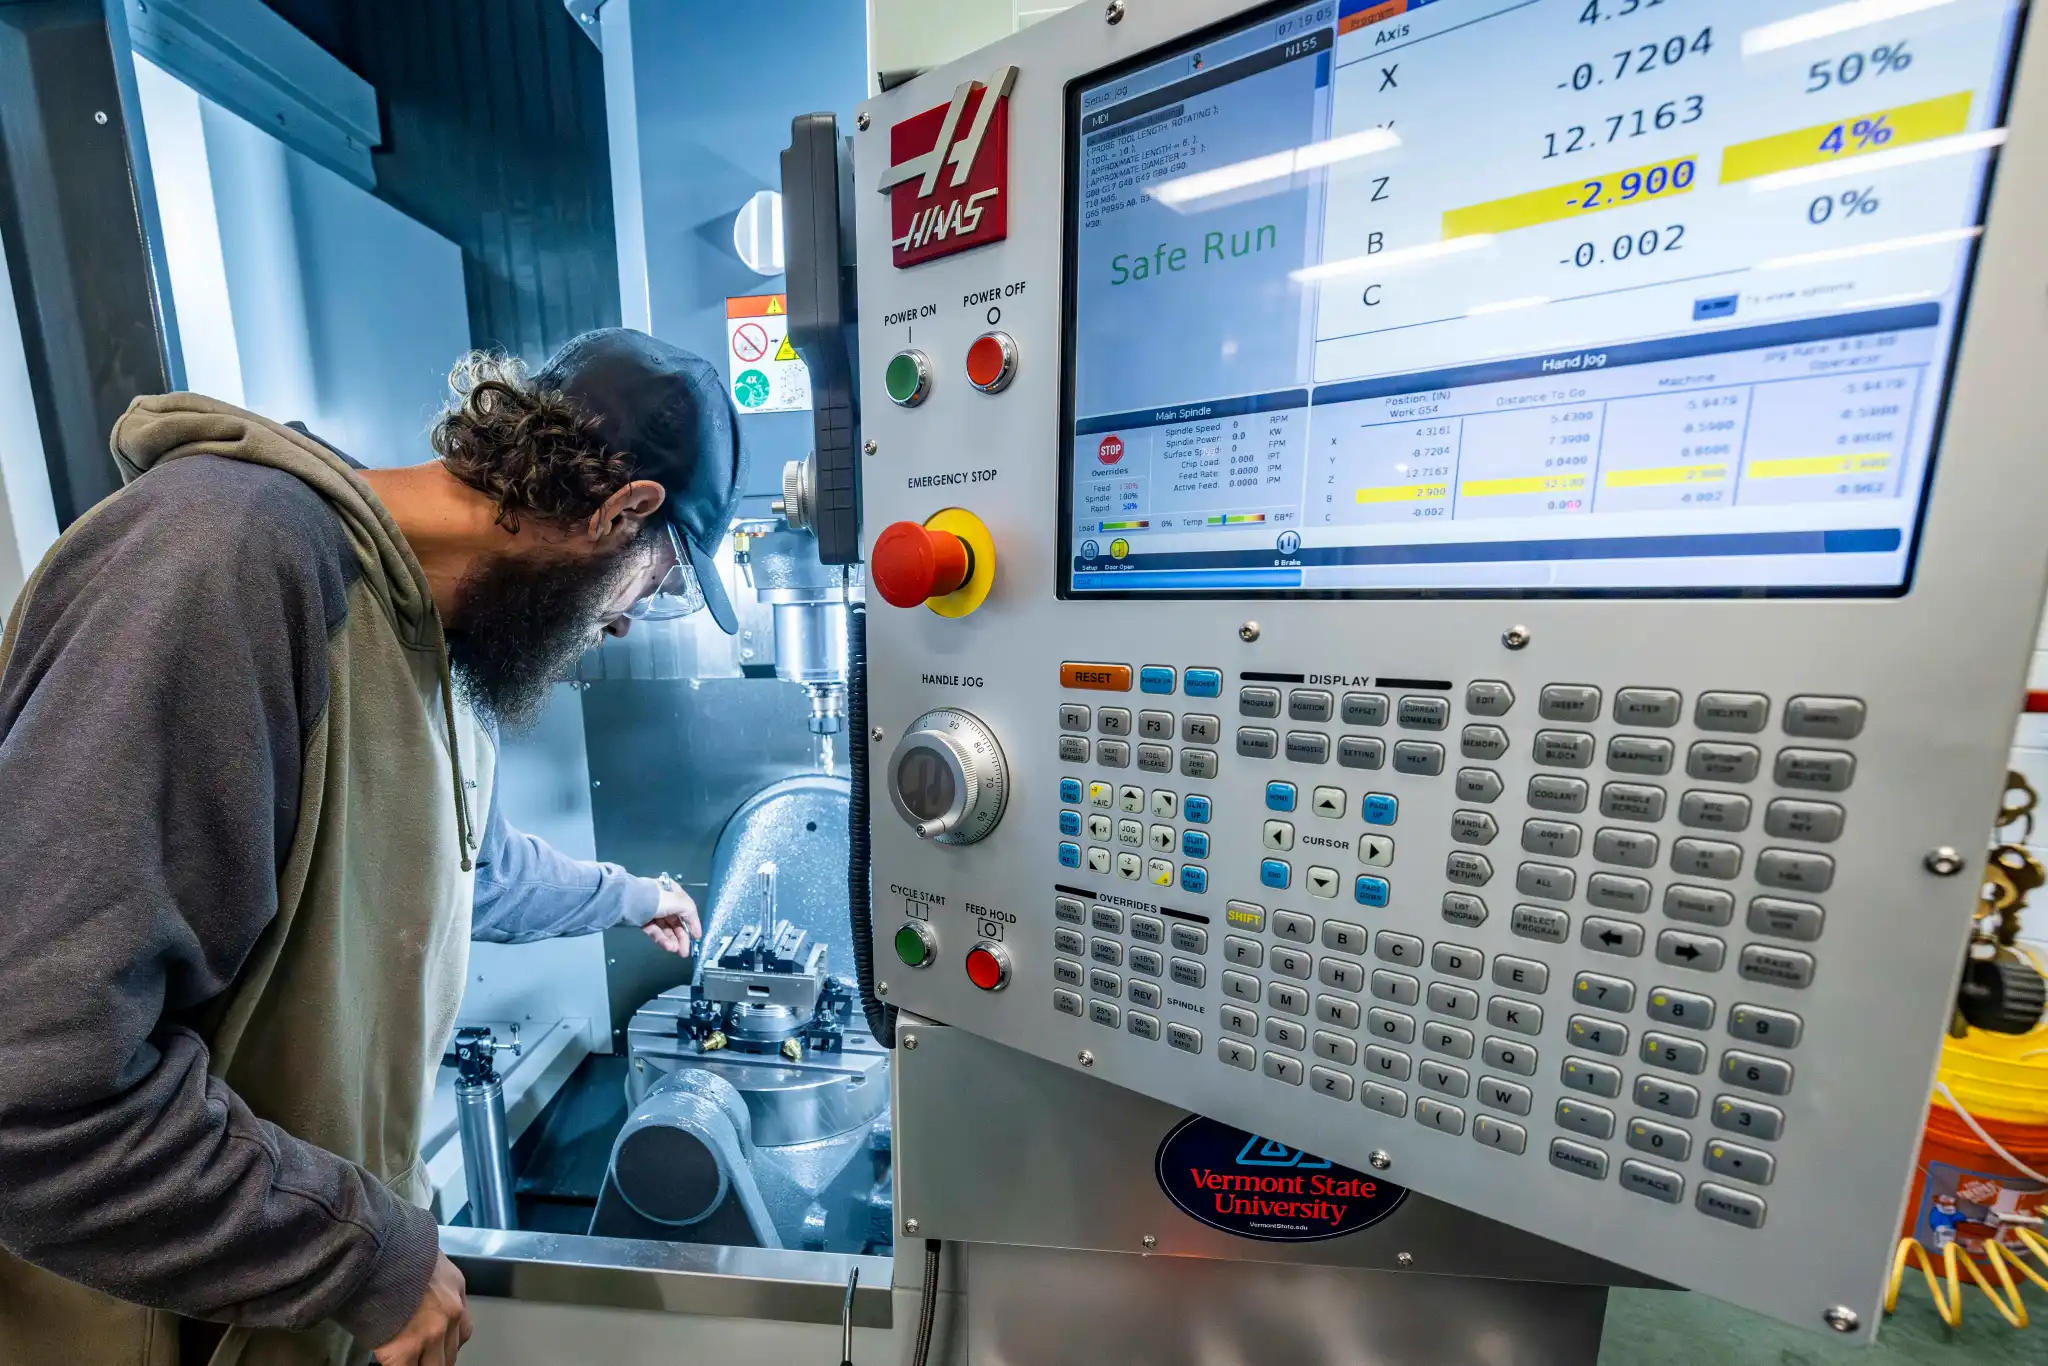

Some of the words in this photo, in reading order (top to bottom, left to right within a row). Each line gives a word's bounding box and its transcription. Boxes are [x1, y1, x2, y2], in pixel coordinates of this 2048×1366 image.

[1375, 24, 1410, 46] Axis
[1556, 27, 1714, 90] -0.7204
[1805, 40, 1914, 93] 50%
[1379, 64, 1398, 92] X
[1092, 112, 1109, 126] MDI
[1542, 94, 1704, 160] 12.7163
[1818, 115, 1892, 153] 4%
[1142, 143, 1172, 159] LENGTH
[1142, 153, 1179, 170] DIAMETER
[1102, 184, 1116, 194] G17
[1371, 176, 1390, 202] Z
[1565, 160, 1695, 209] -2.900
[1808, 186, 1880, 224] 0%
[892, 187, 998, 252] HAAS
[1368, 231, 1384, 255] B
[1560, 225, 1686, 267] -0.002
[1111, 244, 1187, 286] Safe
[1204, 224, 1277, 263] Run
[963, 288, 1001, 307] POWER
[1005, 282, 1026, 297] OFF
[1363, 285, 1382, 306] C
[884, 309, 918, 326] POWER
[921, 304, 936, 318] ON
[1542, 355, 1580, 371] Hand
[1497, 392, 1547, 406] Distance
[1551, 391, 1566, 400] To
[1570, 388, 1586, 397] Go
[1156, 412, 1176, 420] Main
[1180, 407, 1212, 418] Spindle
[1390, 410, 1416, 418] Work
[1166, 427, 1192, 436] Spindle
[1166, 438, 1194, 448] Spindle
[1196, 436, 1222, 444] Power:
[1101, 445, 1120, 456] STOP
[1164, 450, 1192, 459] Surface
[1182, 461, 1197, 469] Chip
[1230, 467, 1258, 475] 0.0000
[1092, 468, 1128, 476] Overrides
[908, 472, 968, 488] EMERGENCY
[972, 470, 998, 482] STOP
[1174, 483, 1196, 491] Active
[1230, 478, 1258, 487] 0.0000
[1183, 518, 1202, 526] Temp
[922, 674, 959, 686] HANDLE
[962, 677, 984, 687] JOG
[1076, 672, 1111, 683] RESET
[1310, 675, 1369, 686] DISPLAY
[1293, 703, 1324, 712] POSITION
[1349, 707, 1376, 715] OFFSET
[949, 721, 960, 730] 90
[1068, 715, 1078, 724] F1
[1106, 718, 1119, 728] F2
[1147, 720, 1161, 731] F3
[1191, 724, 1206, 735] F4
[974, 741, 984, 754] 80
[1464, 740, 1499, 748] MEMORY
[986, 777, 994, 789] 70
[1535, 790, 1577, 800] COOLANT
[1302, 836, 1349, 850] CURSOR
[1537, 879, 1552, 887] ALL
[891, 884, 917, 898] CYCLE
[921, 892, 945, 905] START
[1100, 894, 1157, 913] OVERRIDES
[966, 903, 987, 916] FEED
[990, 909, 1016, 923] HOLD
[1228, 910, 1261, 925] SHIFT
[1287, 922, 1297, 933] A
[1338, 934, 1347, 944] B
[1237, 948, 1246, 957] F
[1392, 944, 1403, 956] C
[1284, 959, 1294, 970] G
[1450, 957, 1461, 969] D
[1059, 968, 1076, 979] FWD
[1334, 971, 1344, 981] H
[1513, 970, 1523, 982] E
[1094, 979, 1116, 989] STOP
[1236, 982, 1243, 992] L
[1391, 984, 1395, 994] I
[1134, 989, 1152, 1000] REV
[1596, 987, 1608, 999] 7
[1168, 998, 1205, 1013] SPINDLE
[1280, 995, 1292, 1005] M
[1447, 996, 1456, 1008] J
[1331, 1008, 1341, 1018] N
[1672, 1004, 1684, 1016] 8
[1232, 1017, 1241, 1027] R
[1507, 1011, 1518, 1023] K
[1384, 1021, 1395, 1032] O
[1756, 1021, 1769, 1034] 9
[1279, 1030, 1288, 1040] S
[1441, 1036, 1452, 1046] P
[1590, 1032, 1600, 1042] 4
[1329, 1043, 1338, 1054] T
[1231, 1051, 1239, 1061] X
[1502, 1051, 1514, 1064] Q
[1666, 1049, 1676, 1061] 5
[1277, 1064, 1286, 1074] Y
[1382, 1058, 1392, 1069] U
[1438, 1074, 1448, 1086] V
[1587, 1074, 1594, 1085] 1
[1747, 1067, 1760, 1081] 6
[1326, 1079, 1335, 1089] Z
[1496, 1090, 1512, 1103] W
[1657, 1092, 1670, 1104] 2
[1739, 1113, 1751, 1126] 3
[1652, 1135, 1663, 1147] 0
[1556, 1151, 1600, 1170] CANCEL
[1190, 1168, 1304, 1194] Vermont
[1310, 1175, 1377, 1197] State
[1215, 1194, 1347, 1226] University
[1249, 1222, 1308, 1230] VermontState.edu
